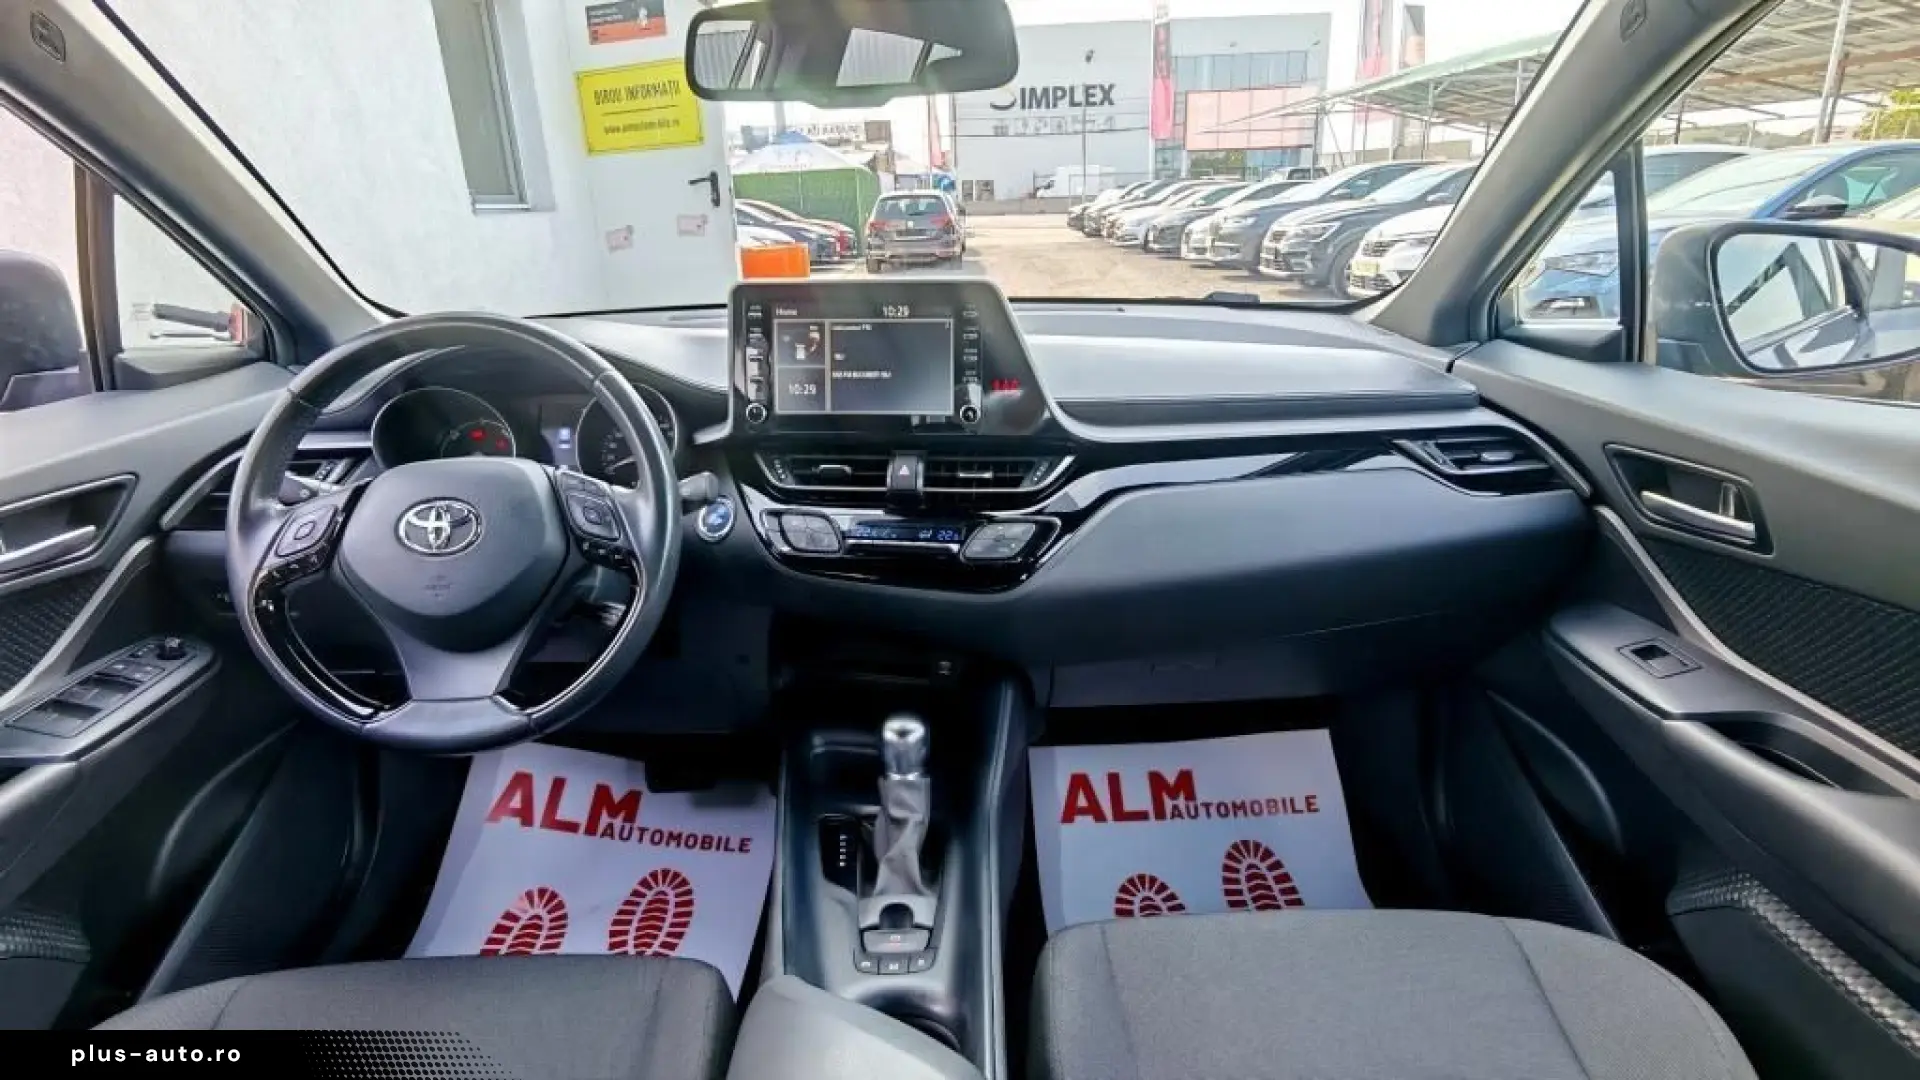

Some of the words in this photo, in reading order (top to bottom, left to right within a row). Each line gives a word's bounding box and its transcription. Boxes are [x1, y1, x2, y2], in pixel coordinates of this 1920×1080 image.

[882, 305, 910, 318] 10:29
[788, 383, 817, 395] 10:29
[484, 770, 644, 837] ALM
[600, 822, 753, 854] AUTOMOBILE
[1060, 768, 1197, 824] ALM
[1169, 795, 1320, 821] AUTOMOBILE
